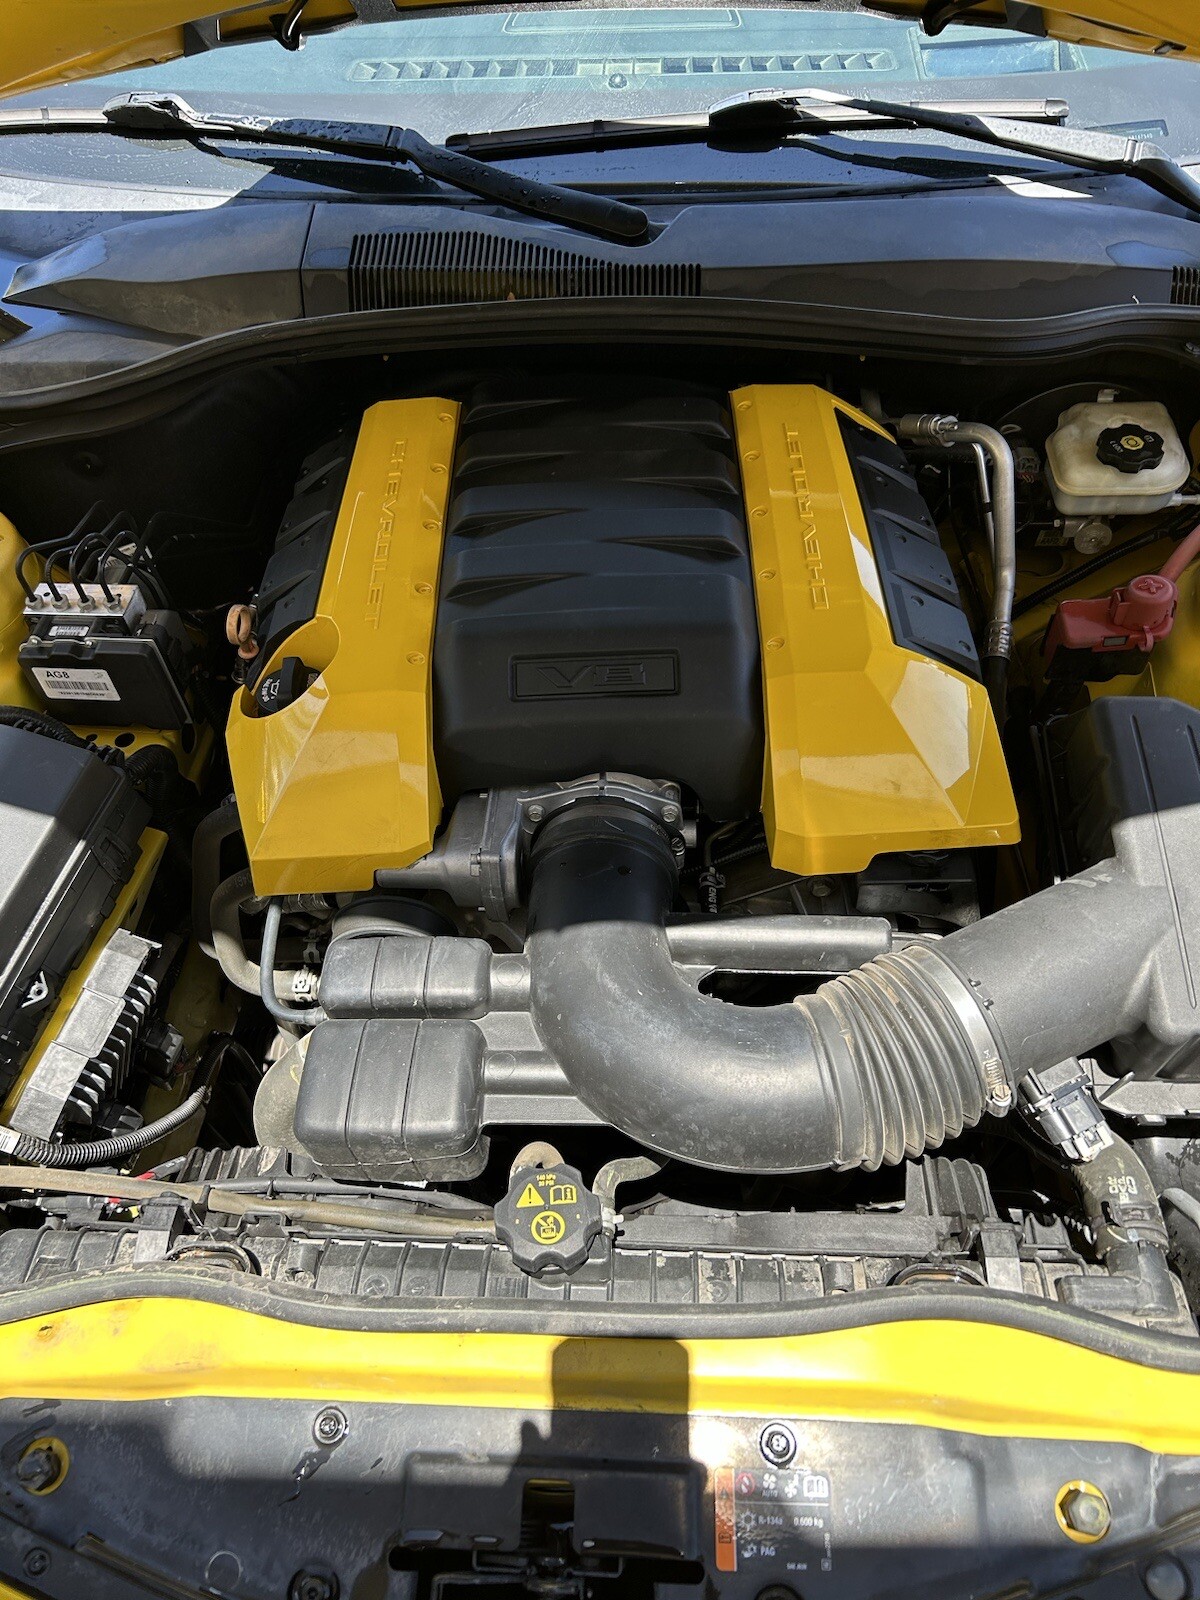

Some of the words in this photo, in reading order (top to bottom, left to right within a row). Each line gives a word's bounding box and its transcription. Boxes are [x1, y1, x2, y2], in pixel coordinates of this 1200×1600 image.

[782, 422, 830, 610] CHEVROLET
[364, 438, 407, 630] CHEVROLET
[46, 671, 70, 679] AG8
[536, 662, 647, 688] V8
[760, 1545, 776, 1557] PAG
